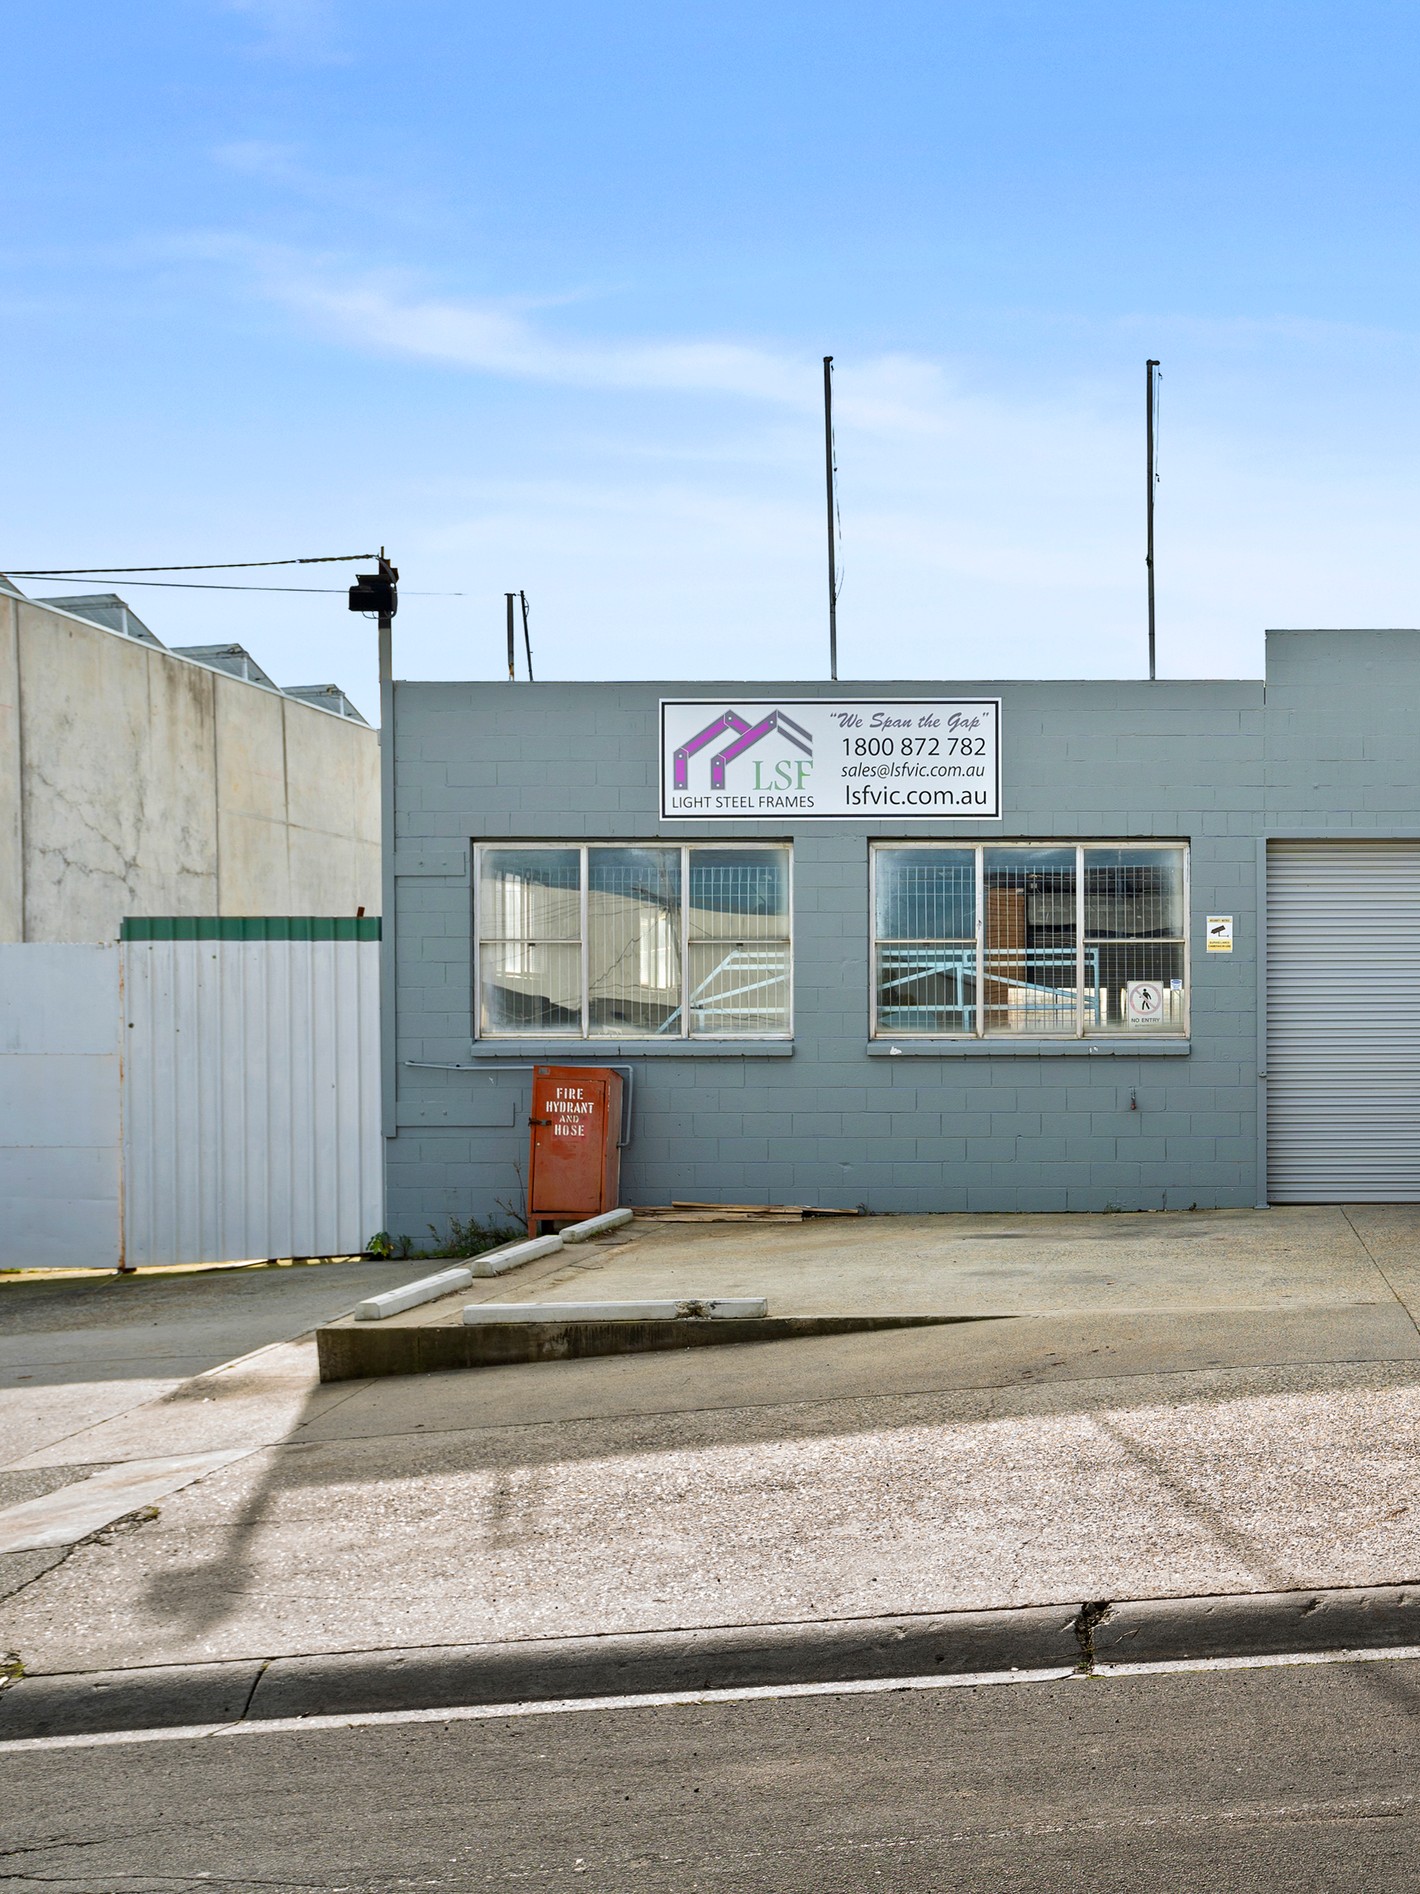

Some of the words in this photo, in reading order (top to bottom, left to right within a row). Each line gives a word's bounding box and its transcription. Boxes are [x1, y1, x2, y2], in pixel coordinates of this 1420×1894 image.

[869, 711, 913, 732] Span
[917, 712, 941, 728] the
[842, 737, 895, 757] 1800
[900, 737, 940, 757] 872
[946, 737, 987, 757] 782
[752, 759, 814, 792] LSF
[841, 761, 985, 779] sales@lsfvic.com.au
[672, 796, 712, 809] LIGHT
[715, 796, 755, 809] STEEL
[758, 795, 815, 808] FRAMES
[845, 784, 988, 806] lsfvic.com.au
[556, 1087, 584, 1100] FIRE
[545, 1101, 595, 1114] HYDRANT
[559, 1114, 580, 1124] AND
[554, 1124, 585, 1137] HOSE
